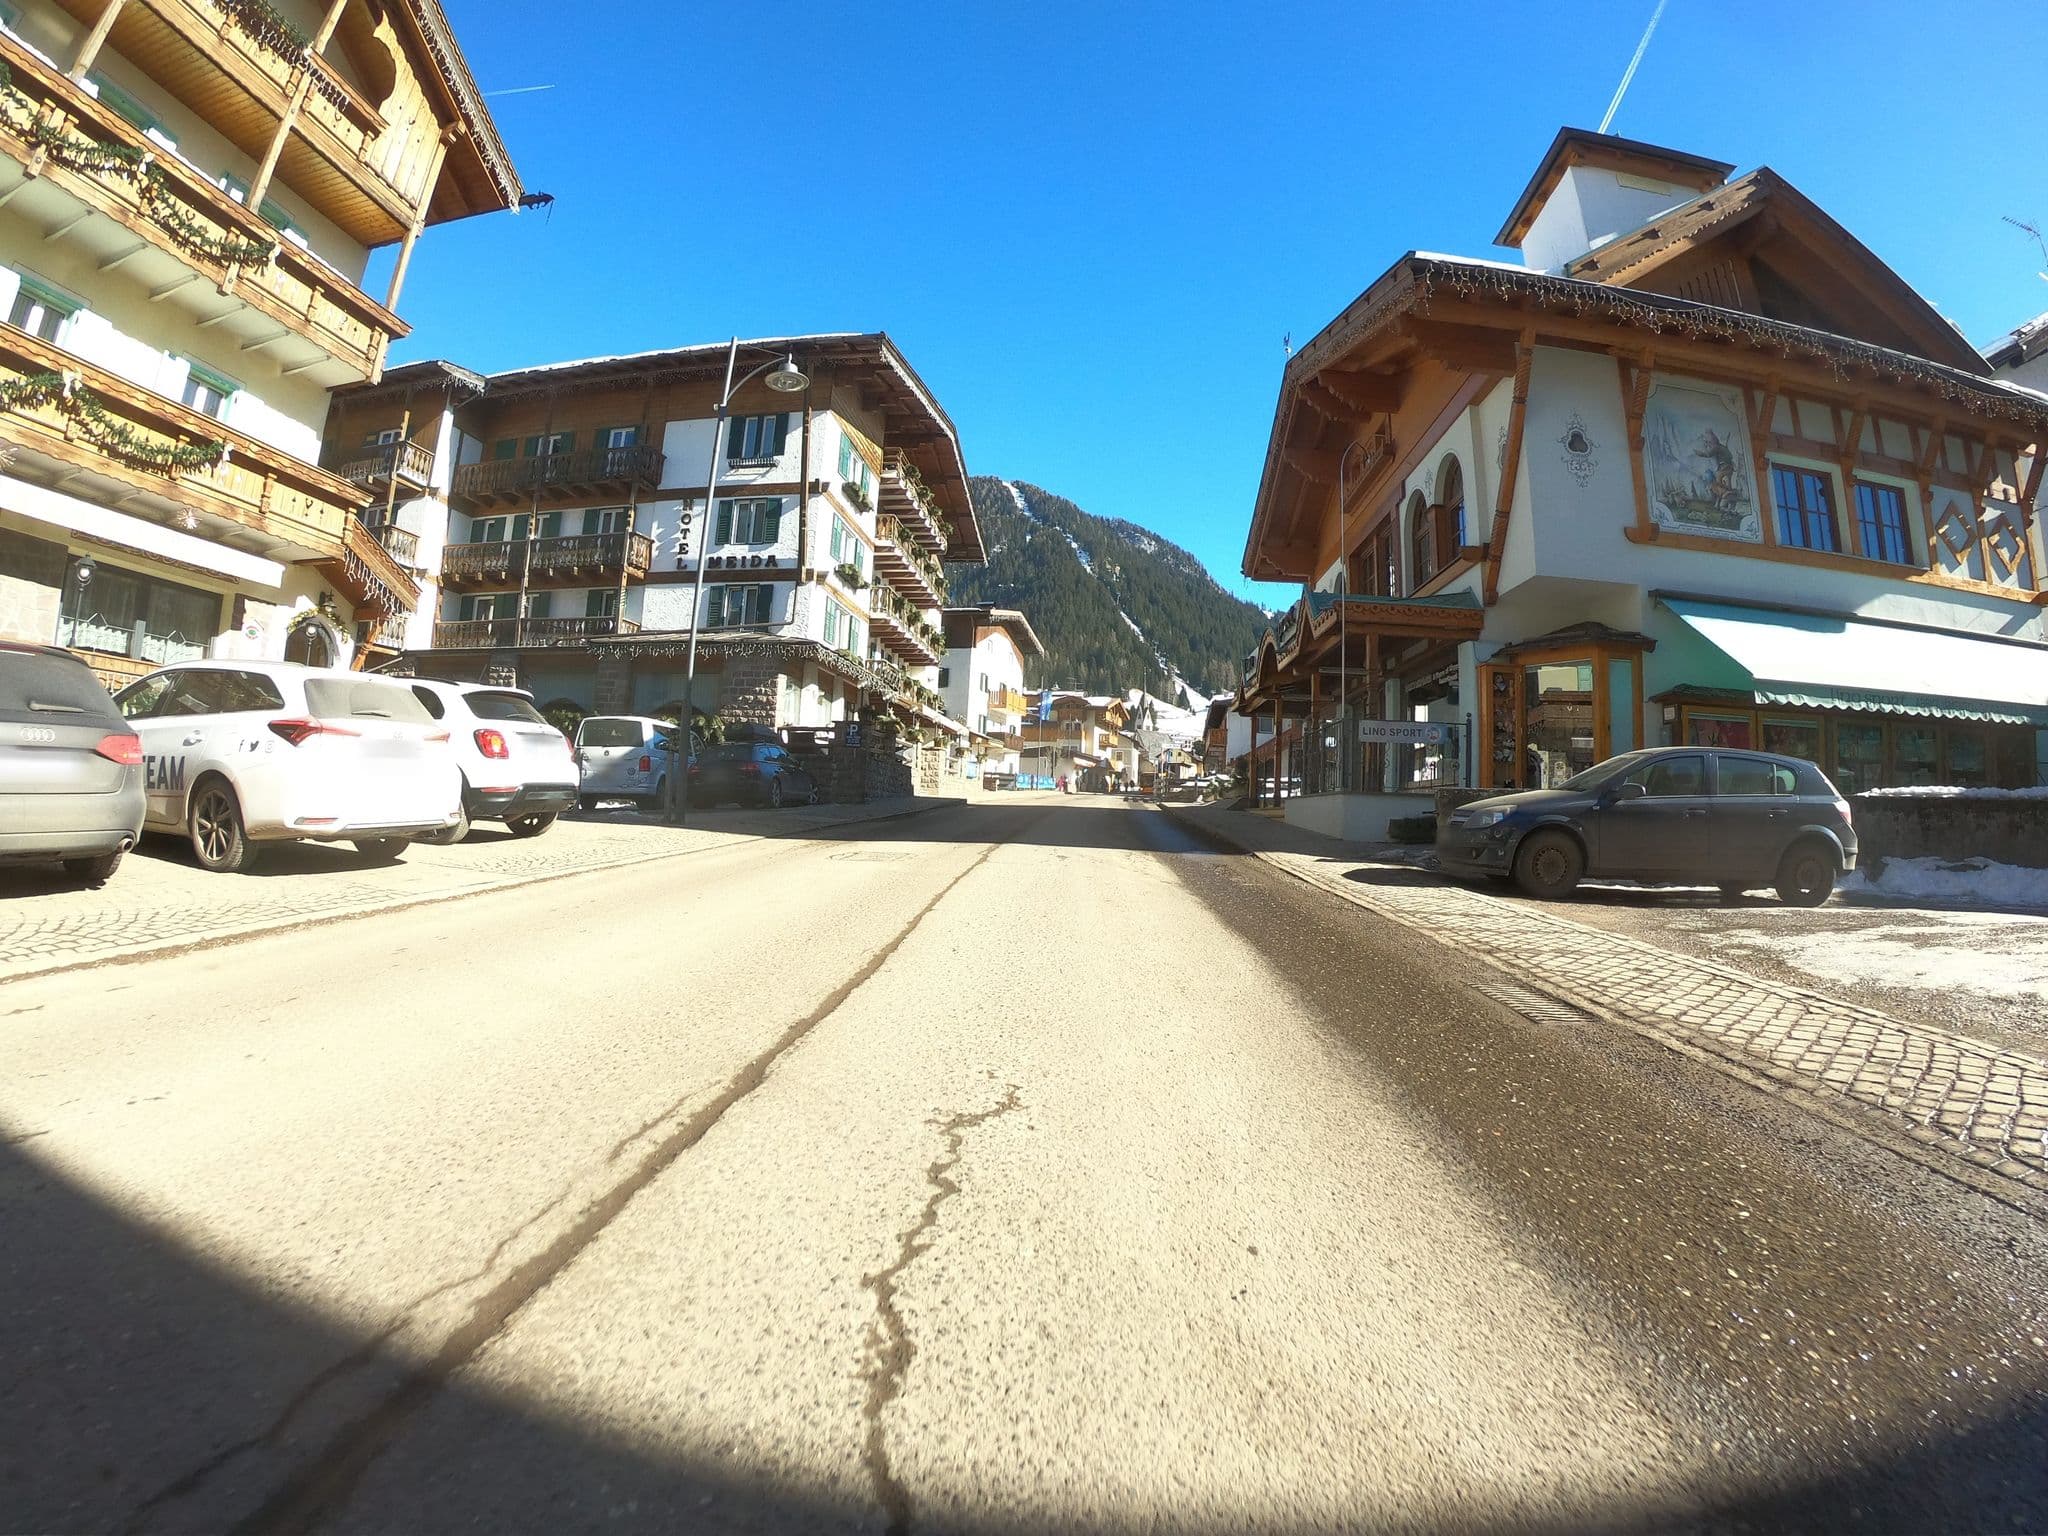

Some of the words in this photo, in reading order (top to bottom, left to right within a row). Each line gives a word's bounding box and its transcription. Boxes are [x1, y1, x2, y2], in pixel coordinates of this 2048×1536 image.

[677, 499, 694, 569] HOTEL
[708, 555, 778, 568] MEIDA
[850, 724, 858, 736] P
[1362, 726, 1386, 736] LINO
[1389, 727, 1424, 737] SPORT
